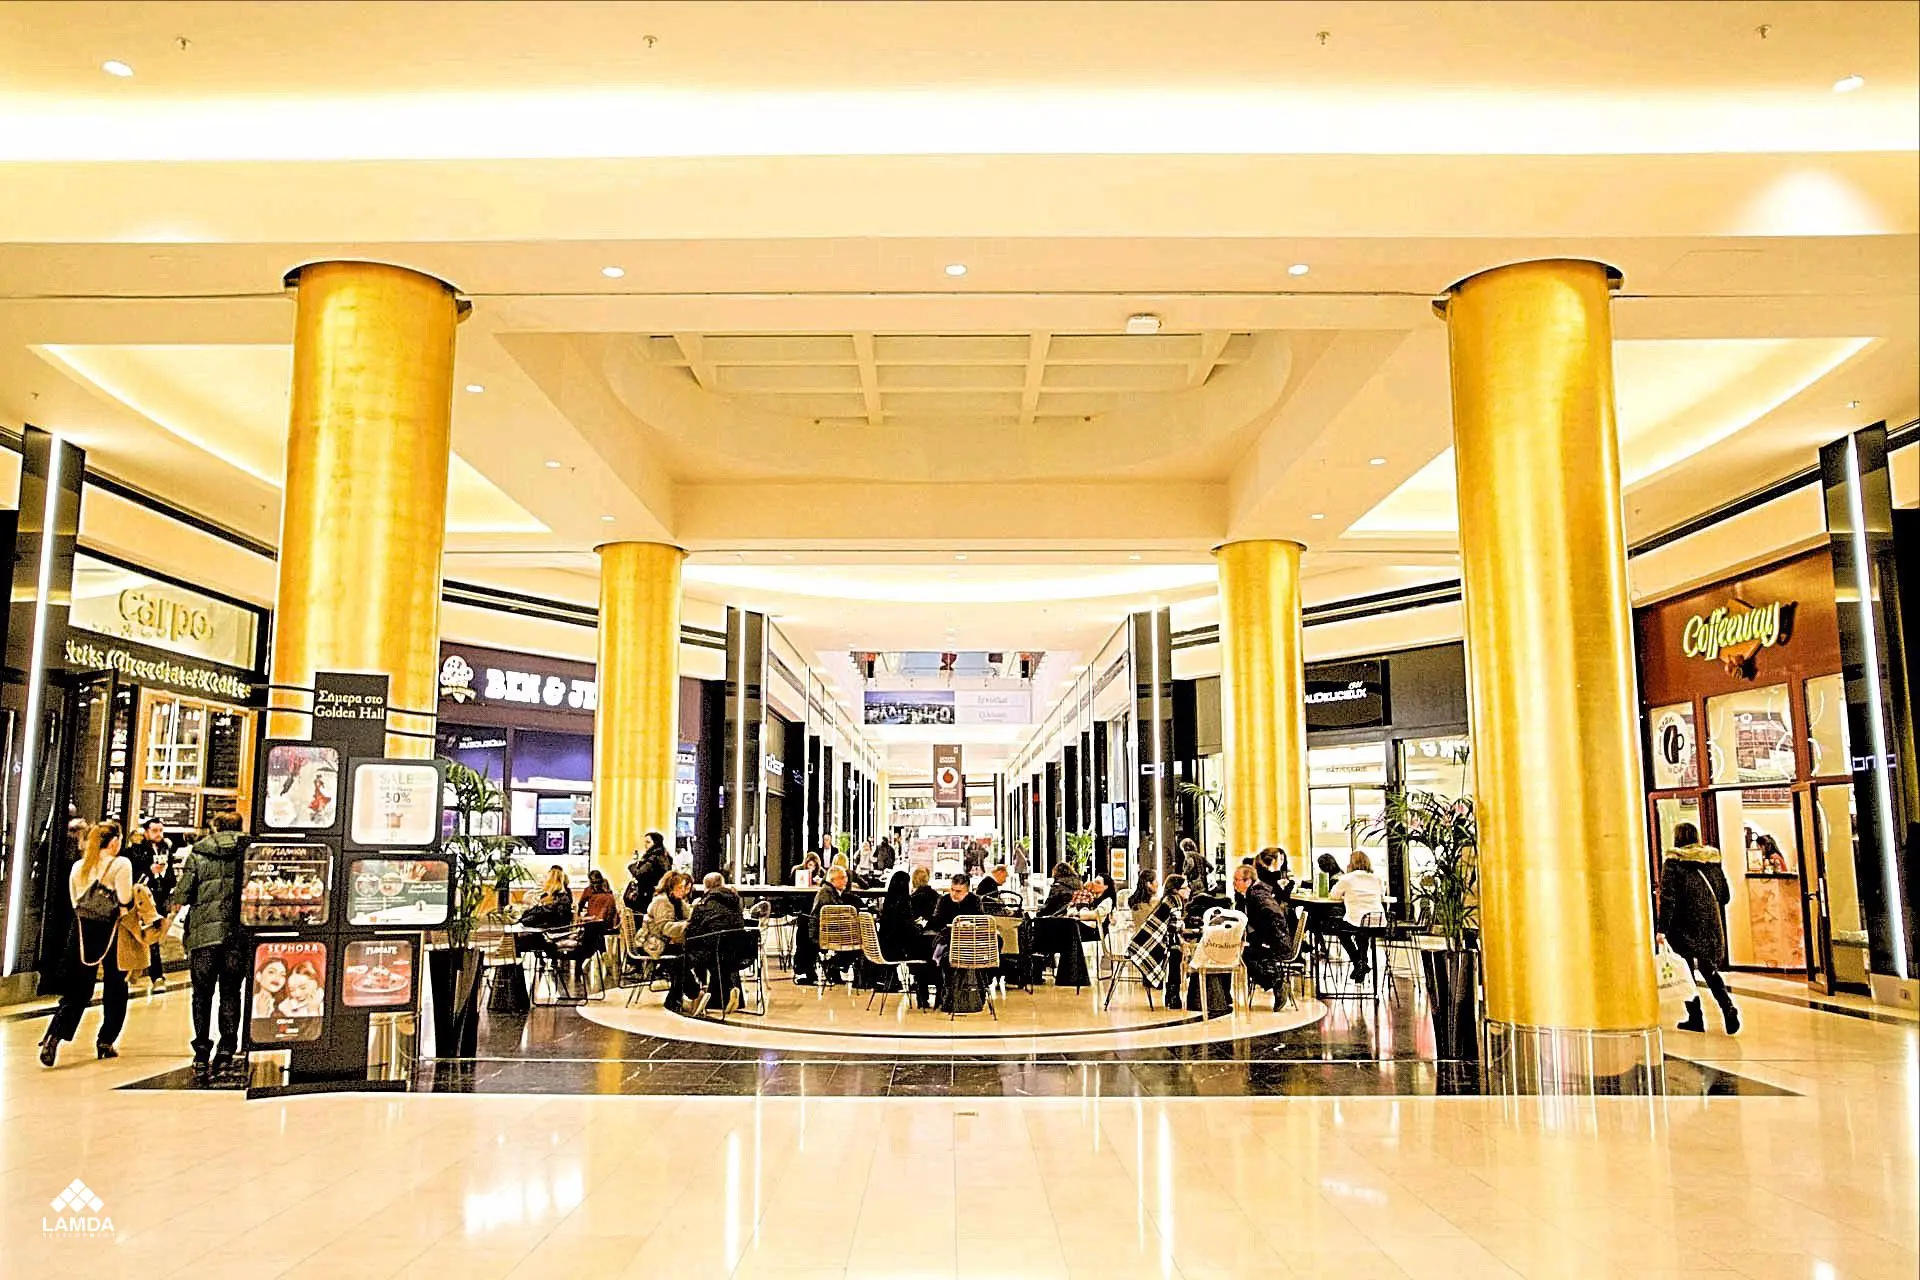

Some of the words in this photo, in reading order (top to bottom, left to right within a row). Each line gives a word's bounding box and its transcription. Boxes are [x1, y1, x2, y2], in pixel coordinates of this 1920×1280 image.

[1683, 601, 1780, 661] Coffeeway
[543, 676, 566, 706] &
[364, 695, 384, 705] στο
[314, 705, 356, 719] Golden
[359, 706, 385, 720] Hall
[267, 943, 319, 953] SEPHORA
